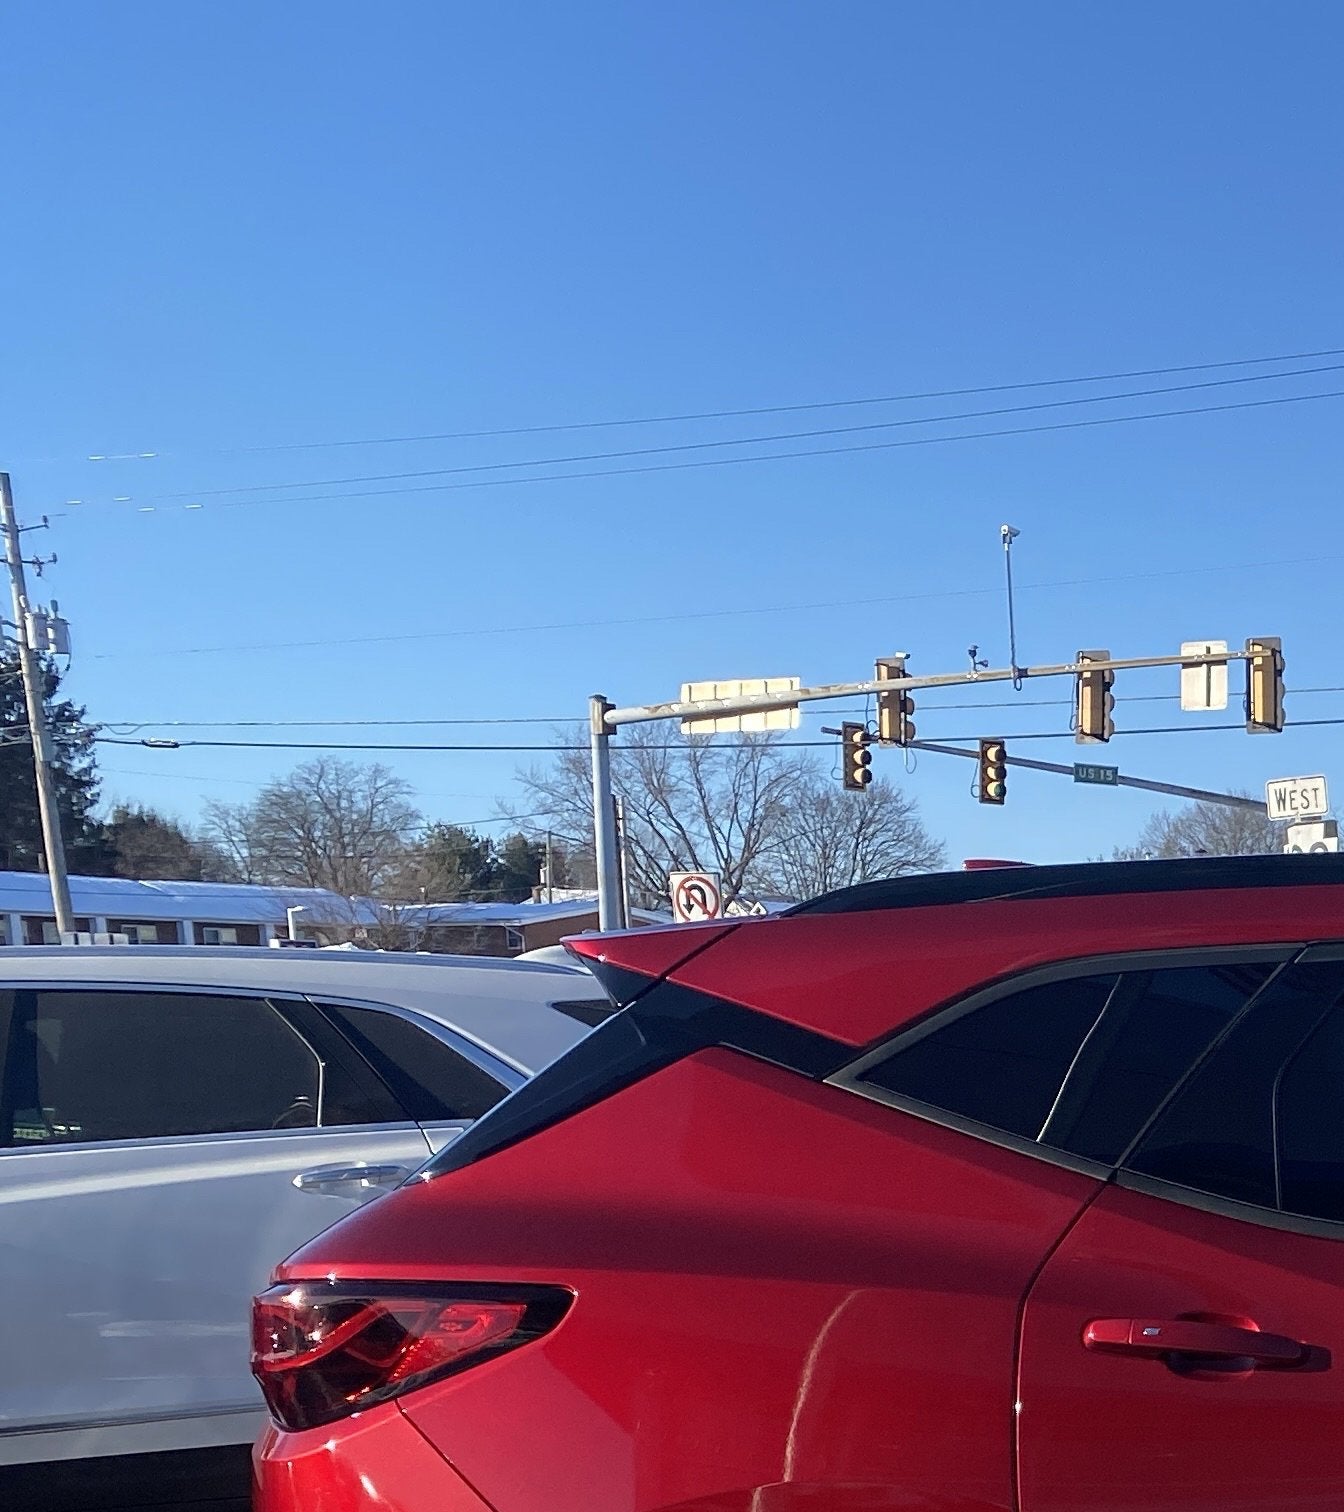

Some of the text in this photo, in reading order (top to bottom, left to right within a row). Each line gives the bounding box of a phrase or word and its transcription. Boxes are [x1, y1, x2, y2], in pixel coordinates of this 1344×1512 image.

[1078, 767, 1113, 781] US 15
[1273, 787, 1320, 813] WEST
